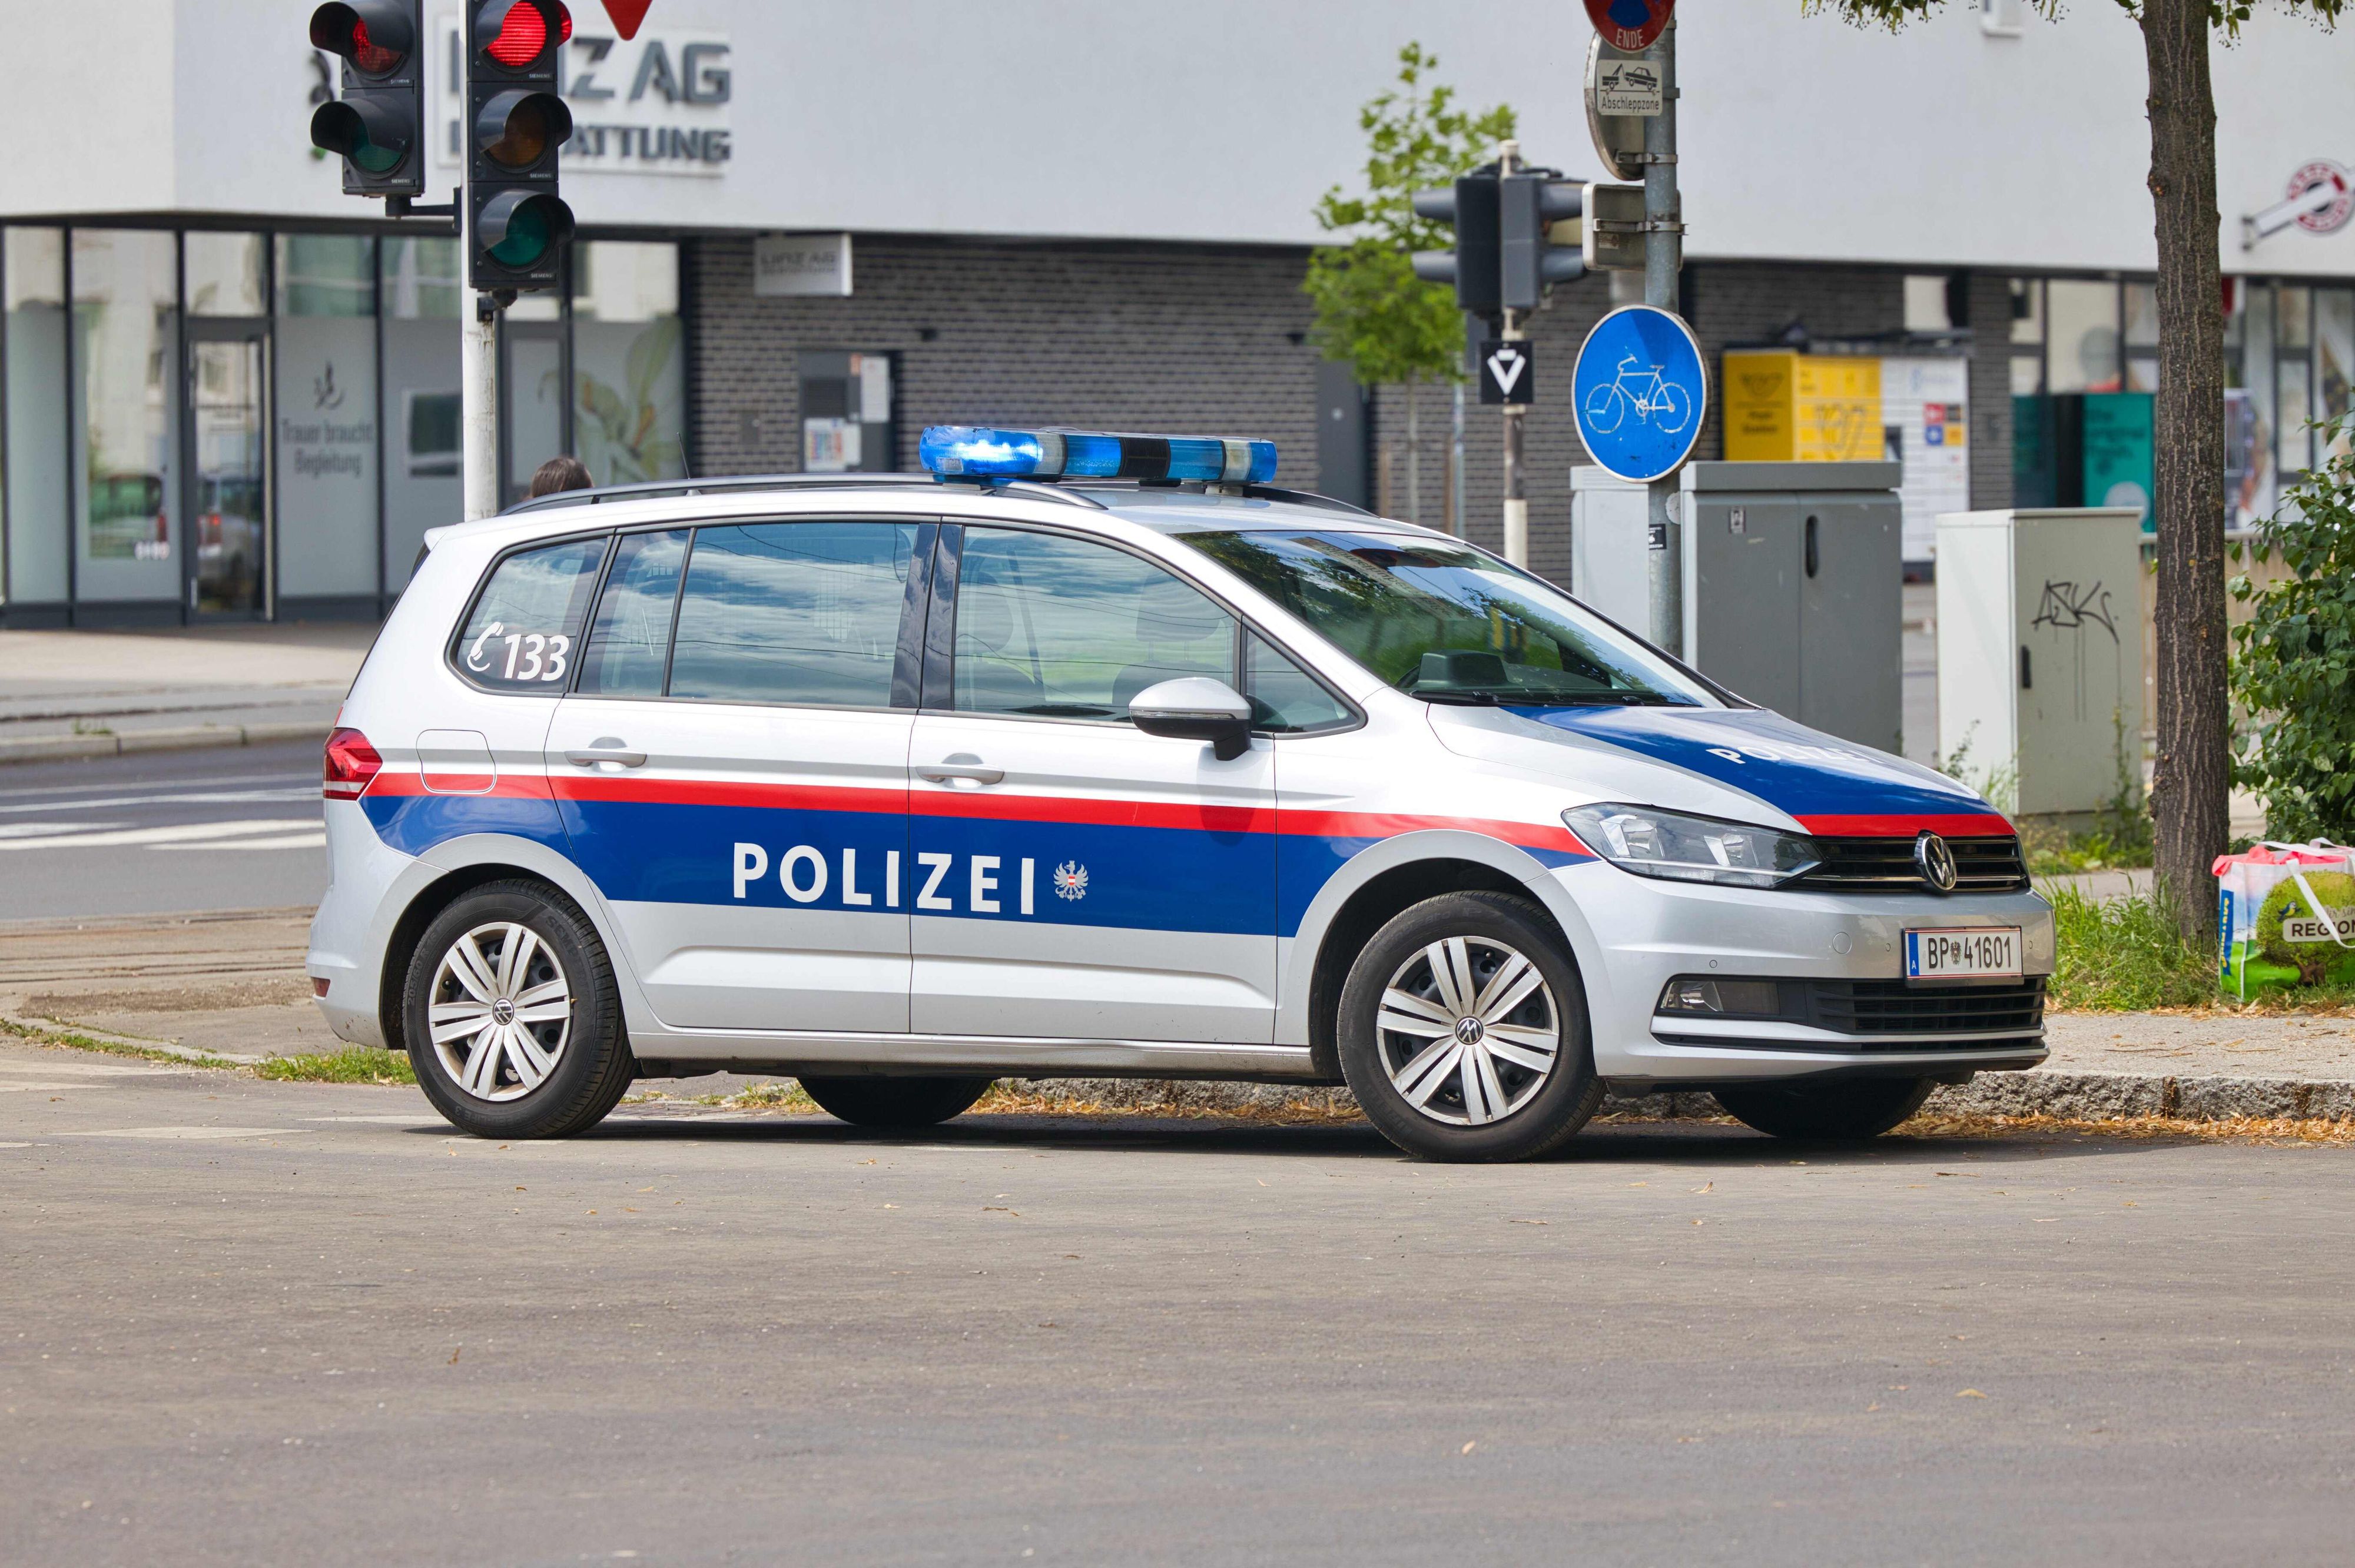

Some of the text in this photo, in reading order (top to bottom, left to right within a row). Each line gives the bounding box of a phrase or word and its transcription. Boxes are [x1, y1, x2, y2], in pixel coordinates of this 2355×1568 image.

[1616, 28, 1644, 48] ENDE
[629, 39, 731, 104] AG
[1601, 97, 1659, 112] Abschleppzone
[504, 633, 569, 681] 133
[734, 842, 1034, 915] POLIZEI
[2292, 919, 2355, 937] REGO
[1911, 936, 2011, 969] A BP 41601
